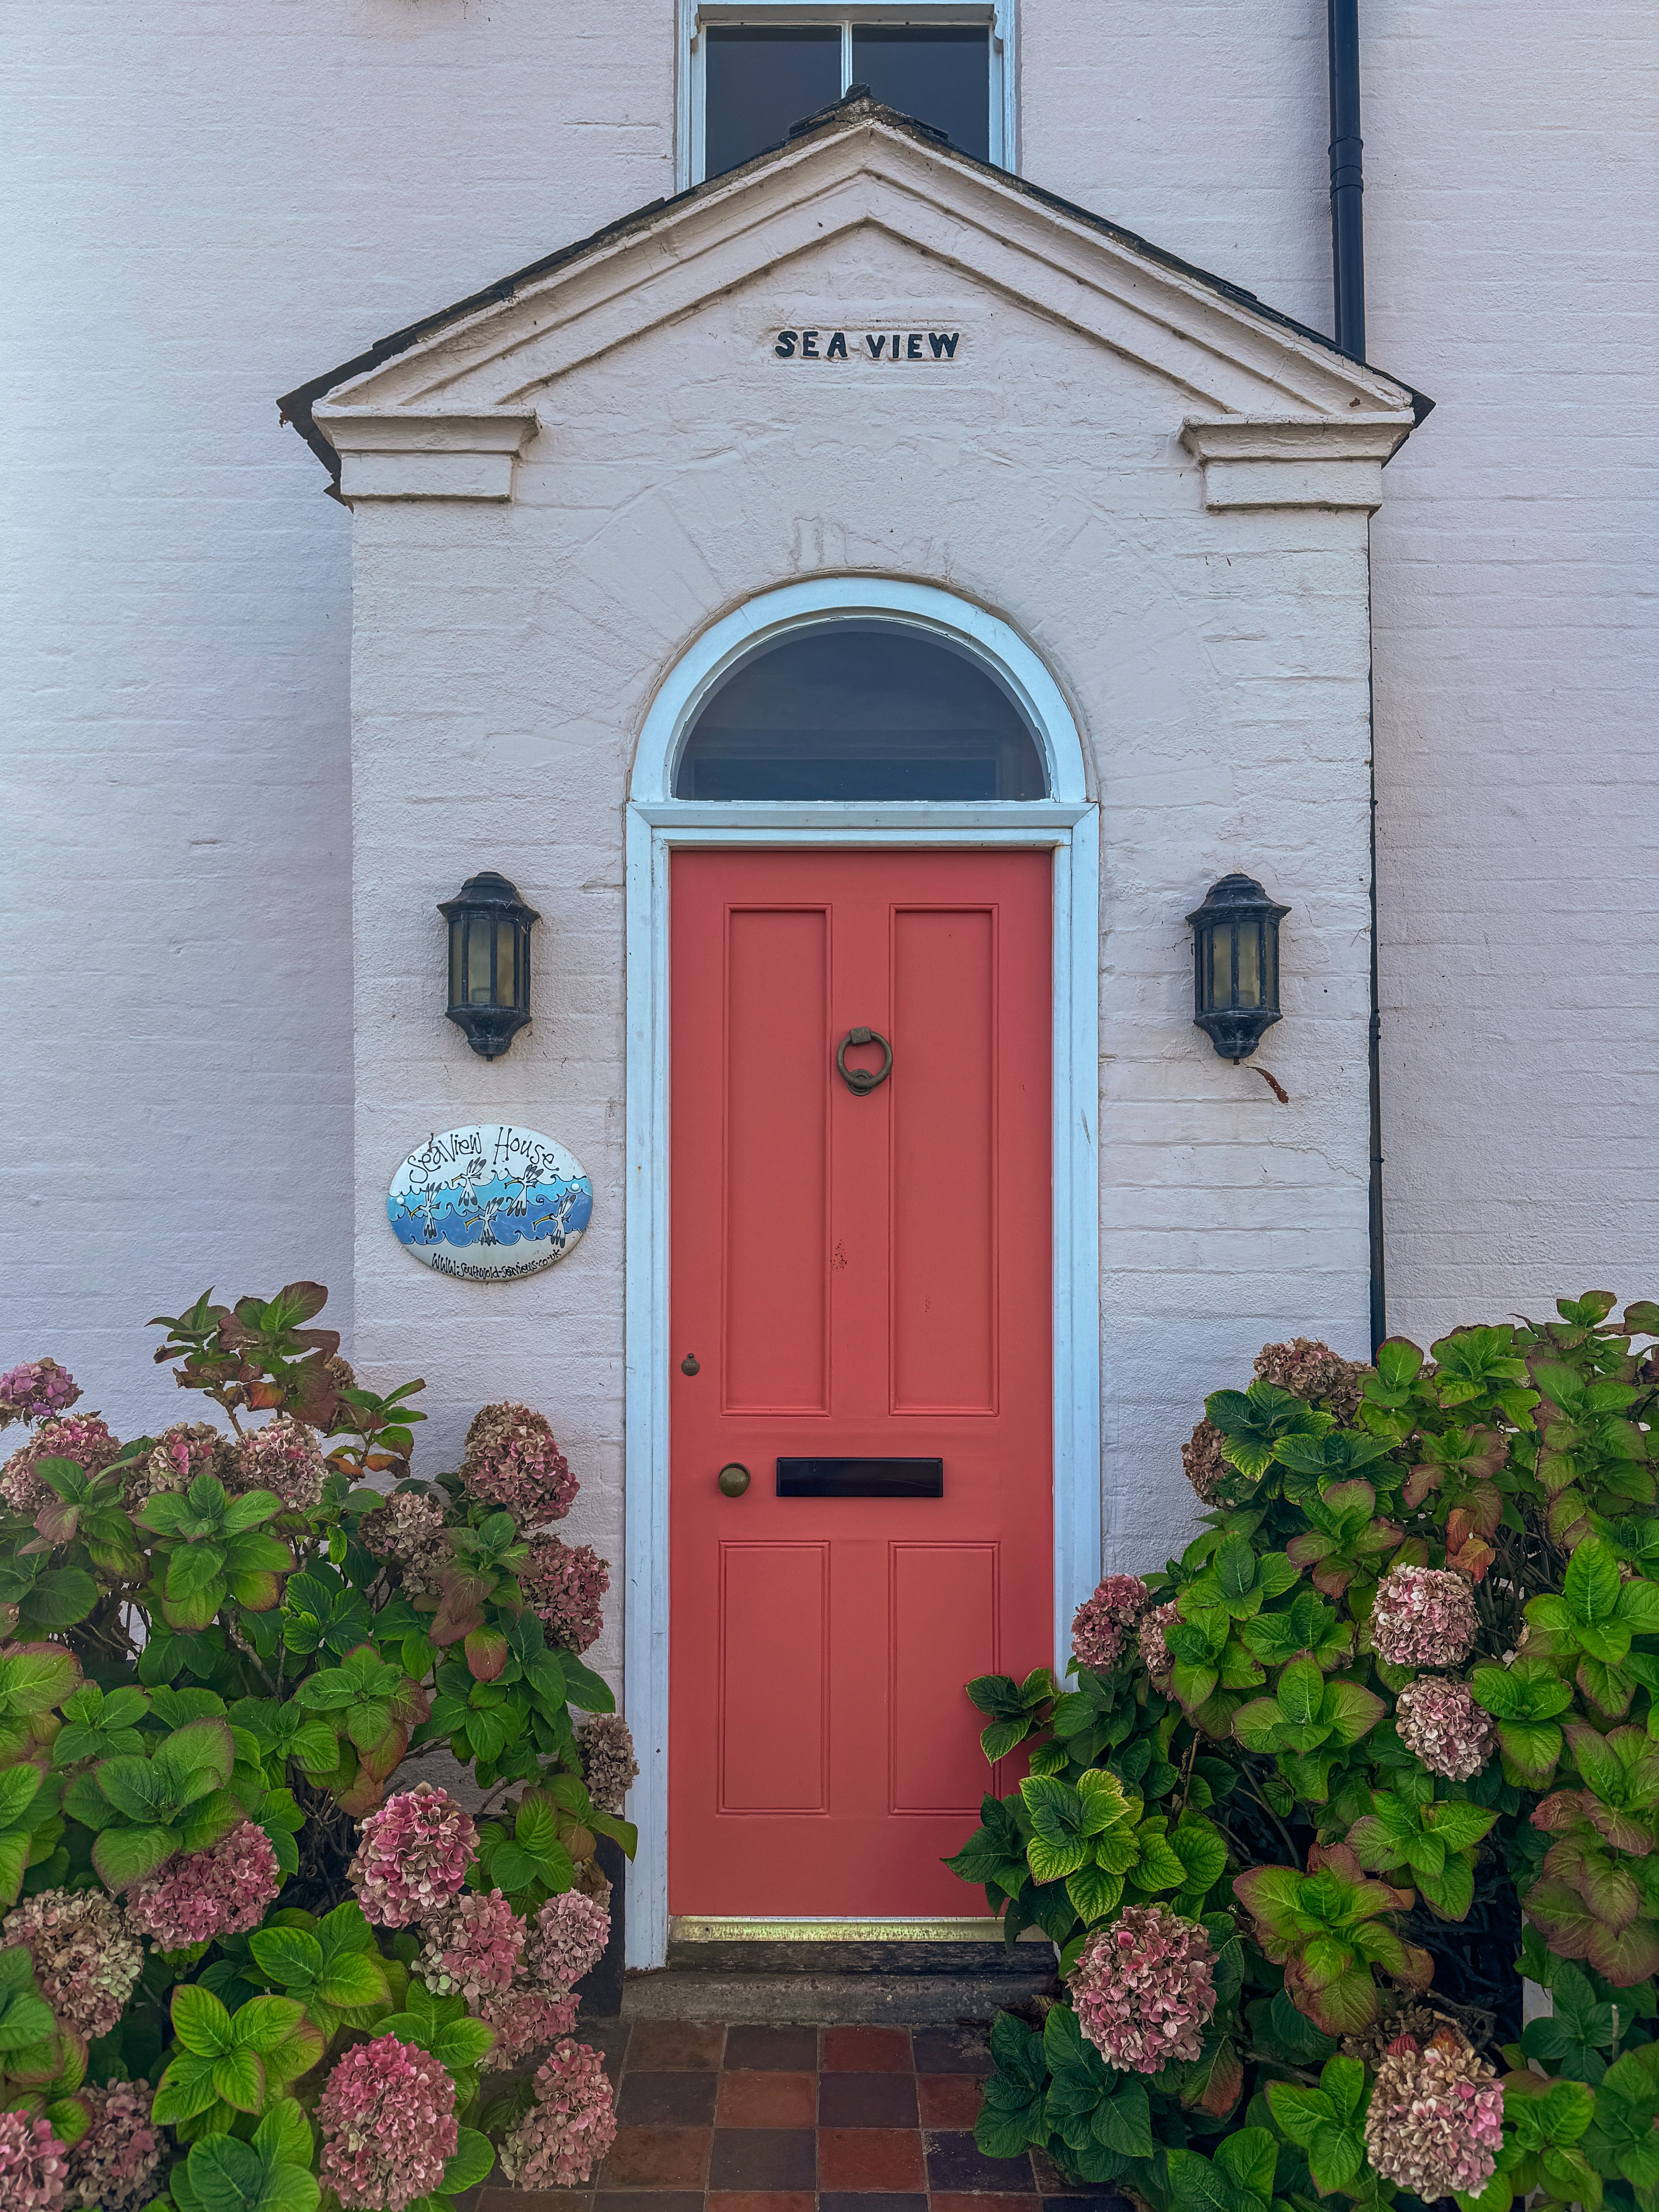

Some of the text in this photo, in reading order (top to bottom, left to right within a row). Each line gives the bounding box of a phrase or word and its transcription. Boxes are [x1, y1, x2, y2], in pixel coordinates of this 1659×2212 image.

[775, 330, 959, 359] SEA VIEW
[493, 1127, 560, 1171] House
